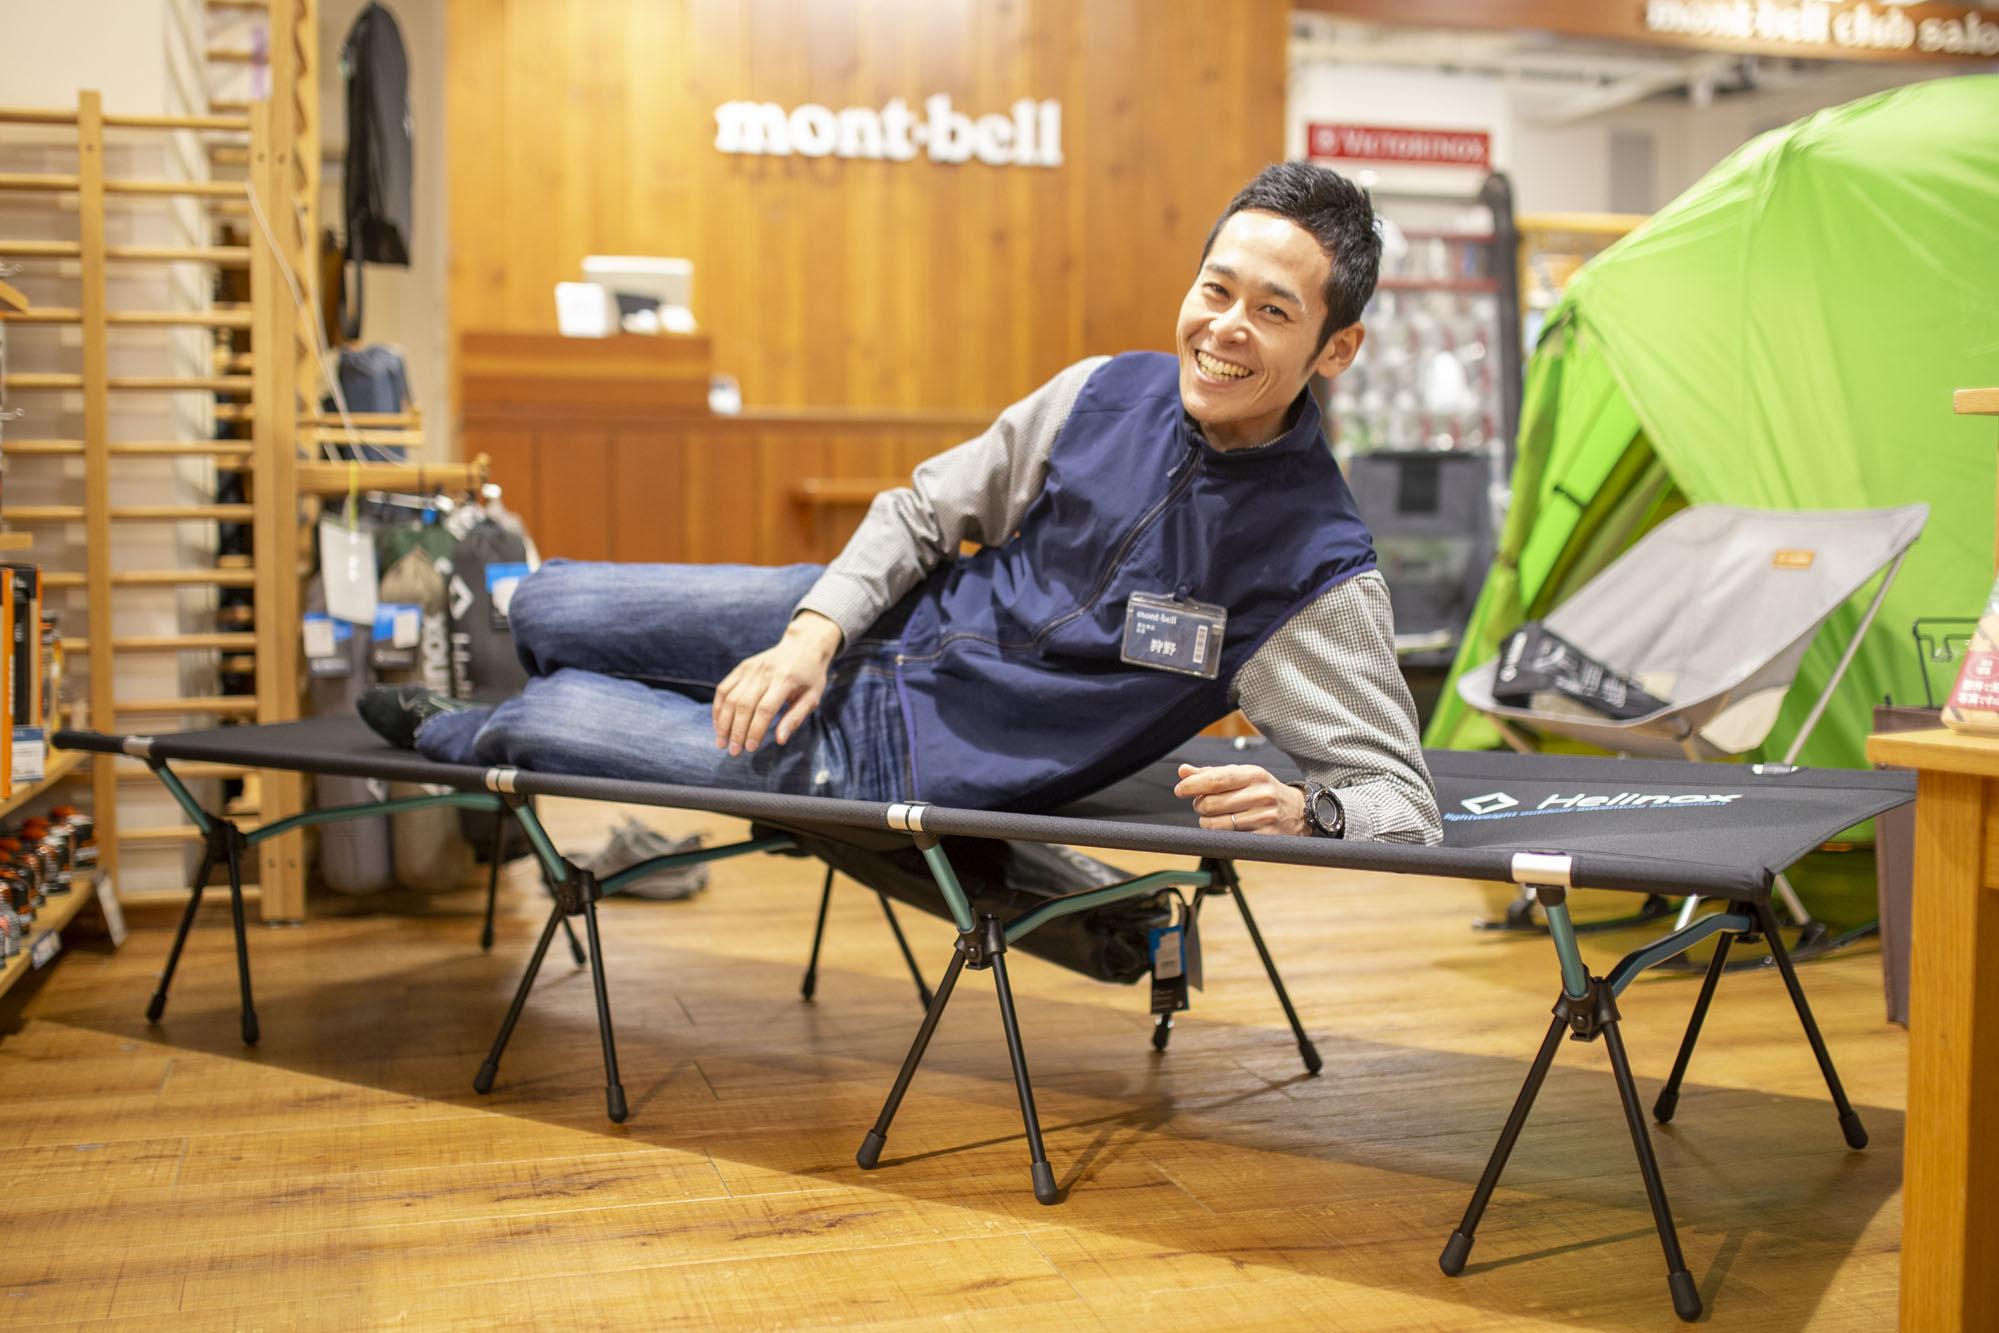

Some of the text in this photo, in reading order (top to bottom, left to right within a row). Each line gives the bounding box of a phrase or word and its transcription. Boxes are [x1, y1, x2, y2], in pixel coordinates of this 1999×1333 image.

[1832, 0, 1916, 49] club
[1537, 791, 1743, 810] Helinox
[1443, 811, 1518, 822] lightweight
